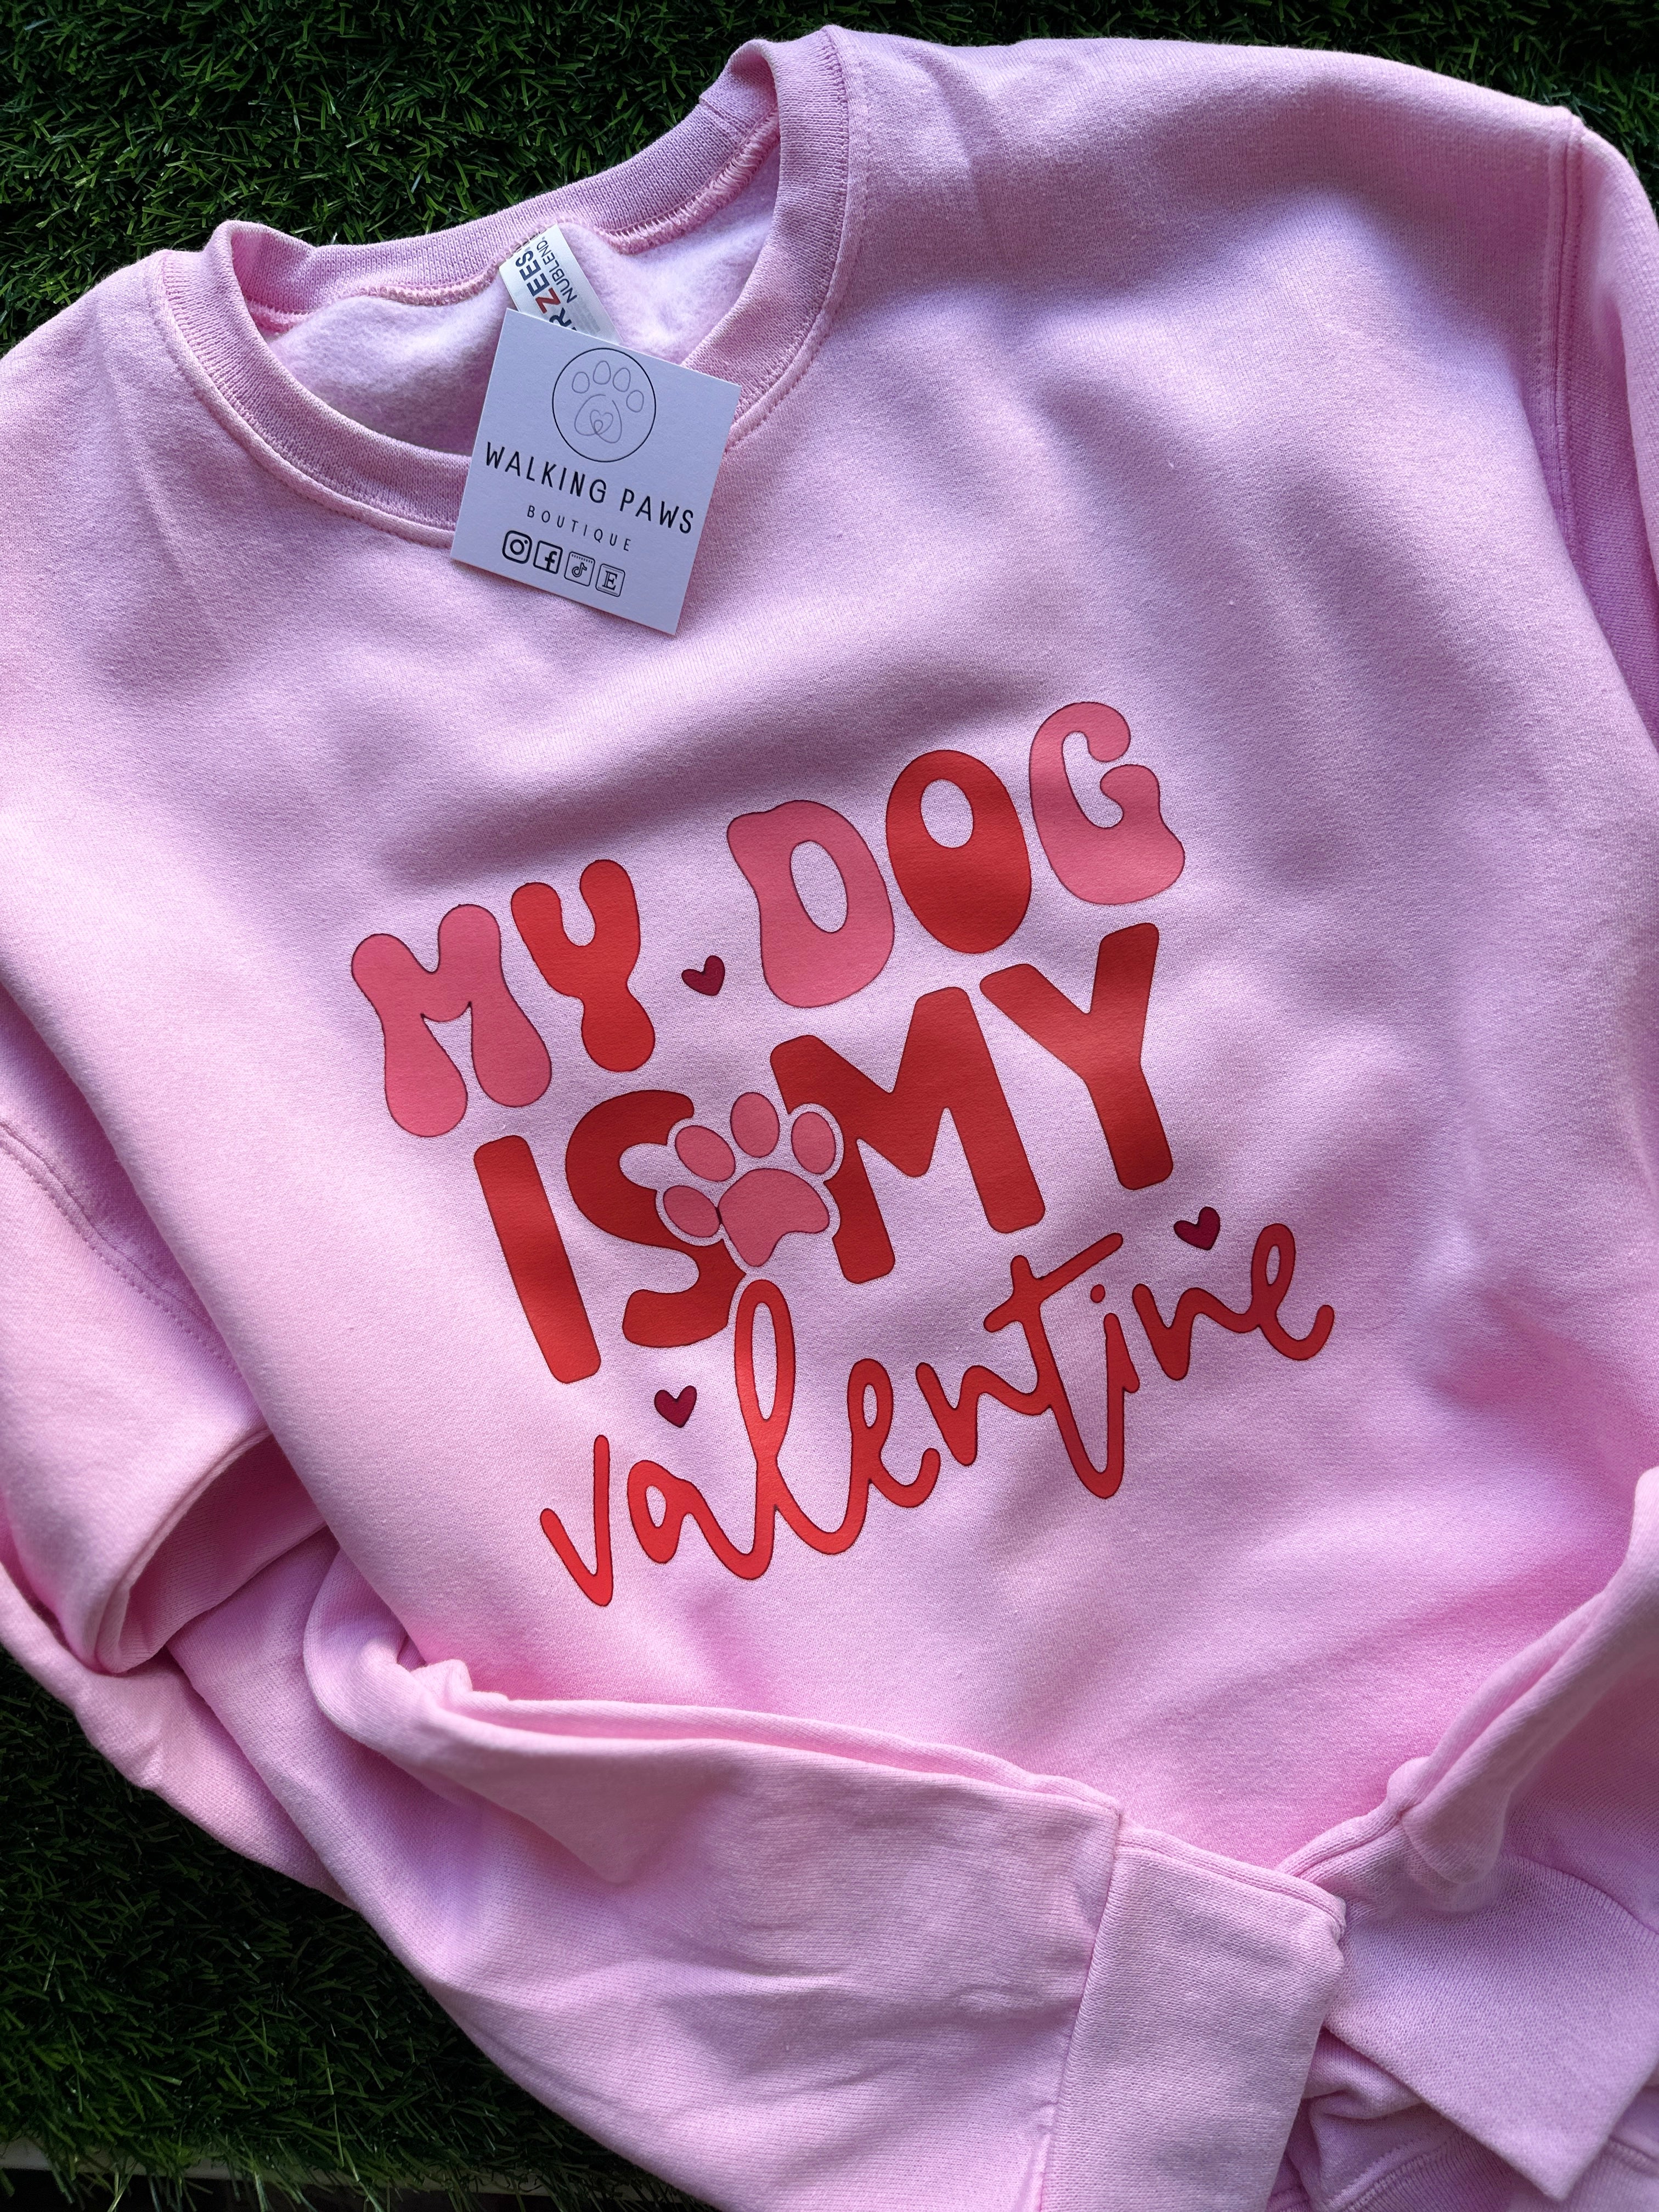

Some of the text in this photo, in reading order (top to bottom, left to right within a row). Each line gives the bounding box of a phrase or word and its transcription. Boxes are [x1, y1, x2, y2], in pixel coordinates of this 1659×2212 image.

[515, 250, 577, 331] RZEES
[537, 240, 577, 303] NUBLEND
[486, 442, 695, 534] WALKING PAWS
[527, 505, 631, 552] BOUTIQUE
[351, 702, 1186, 1138] MY DOG
[473, 923, 1174, 1384] IS MY
[540, 1223, 1335, 1607] valentine
